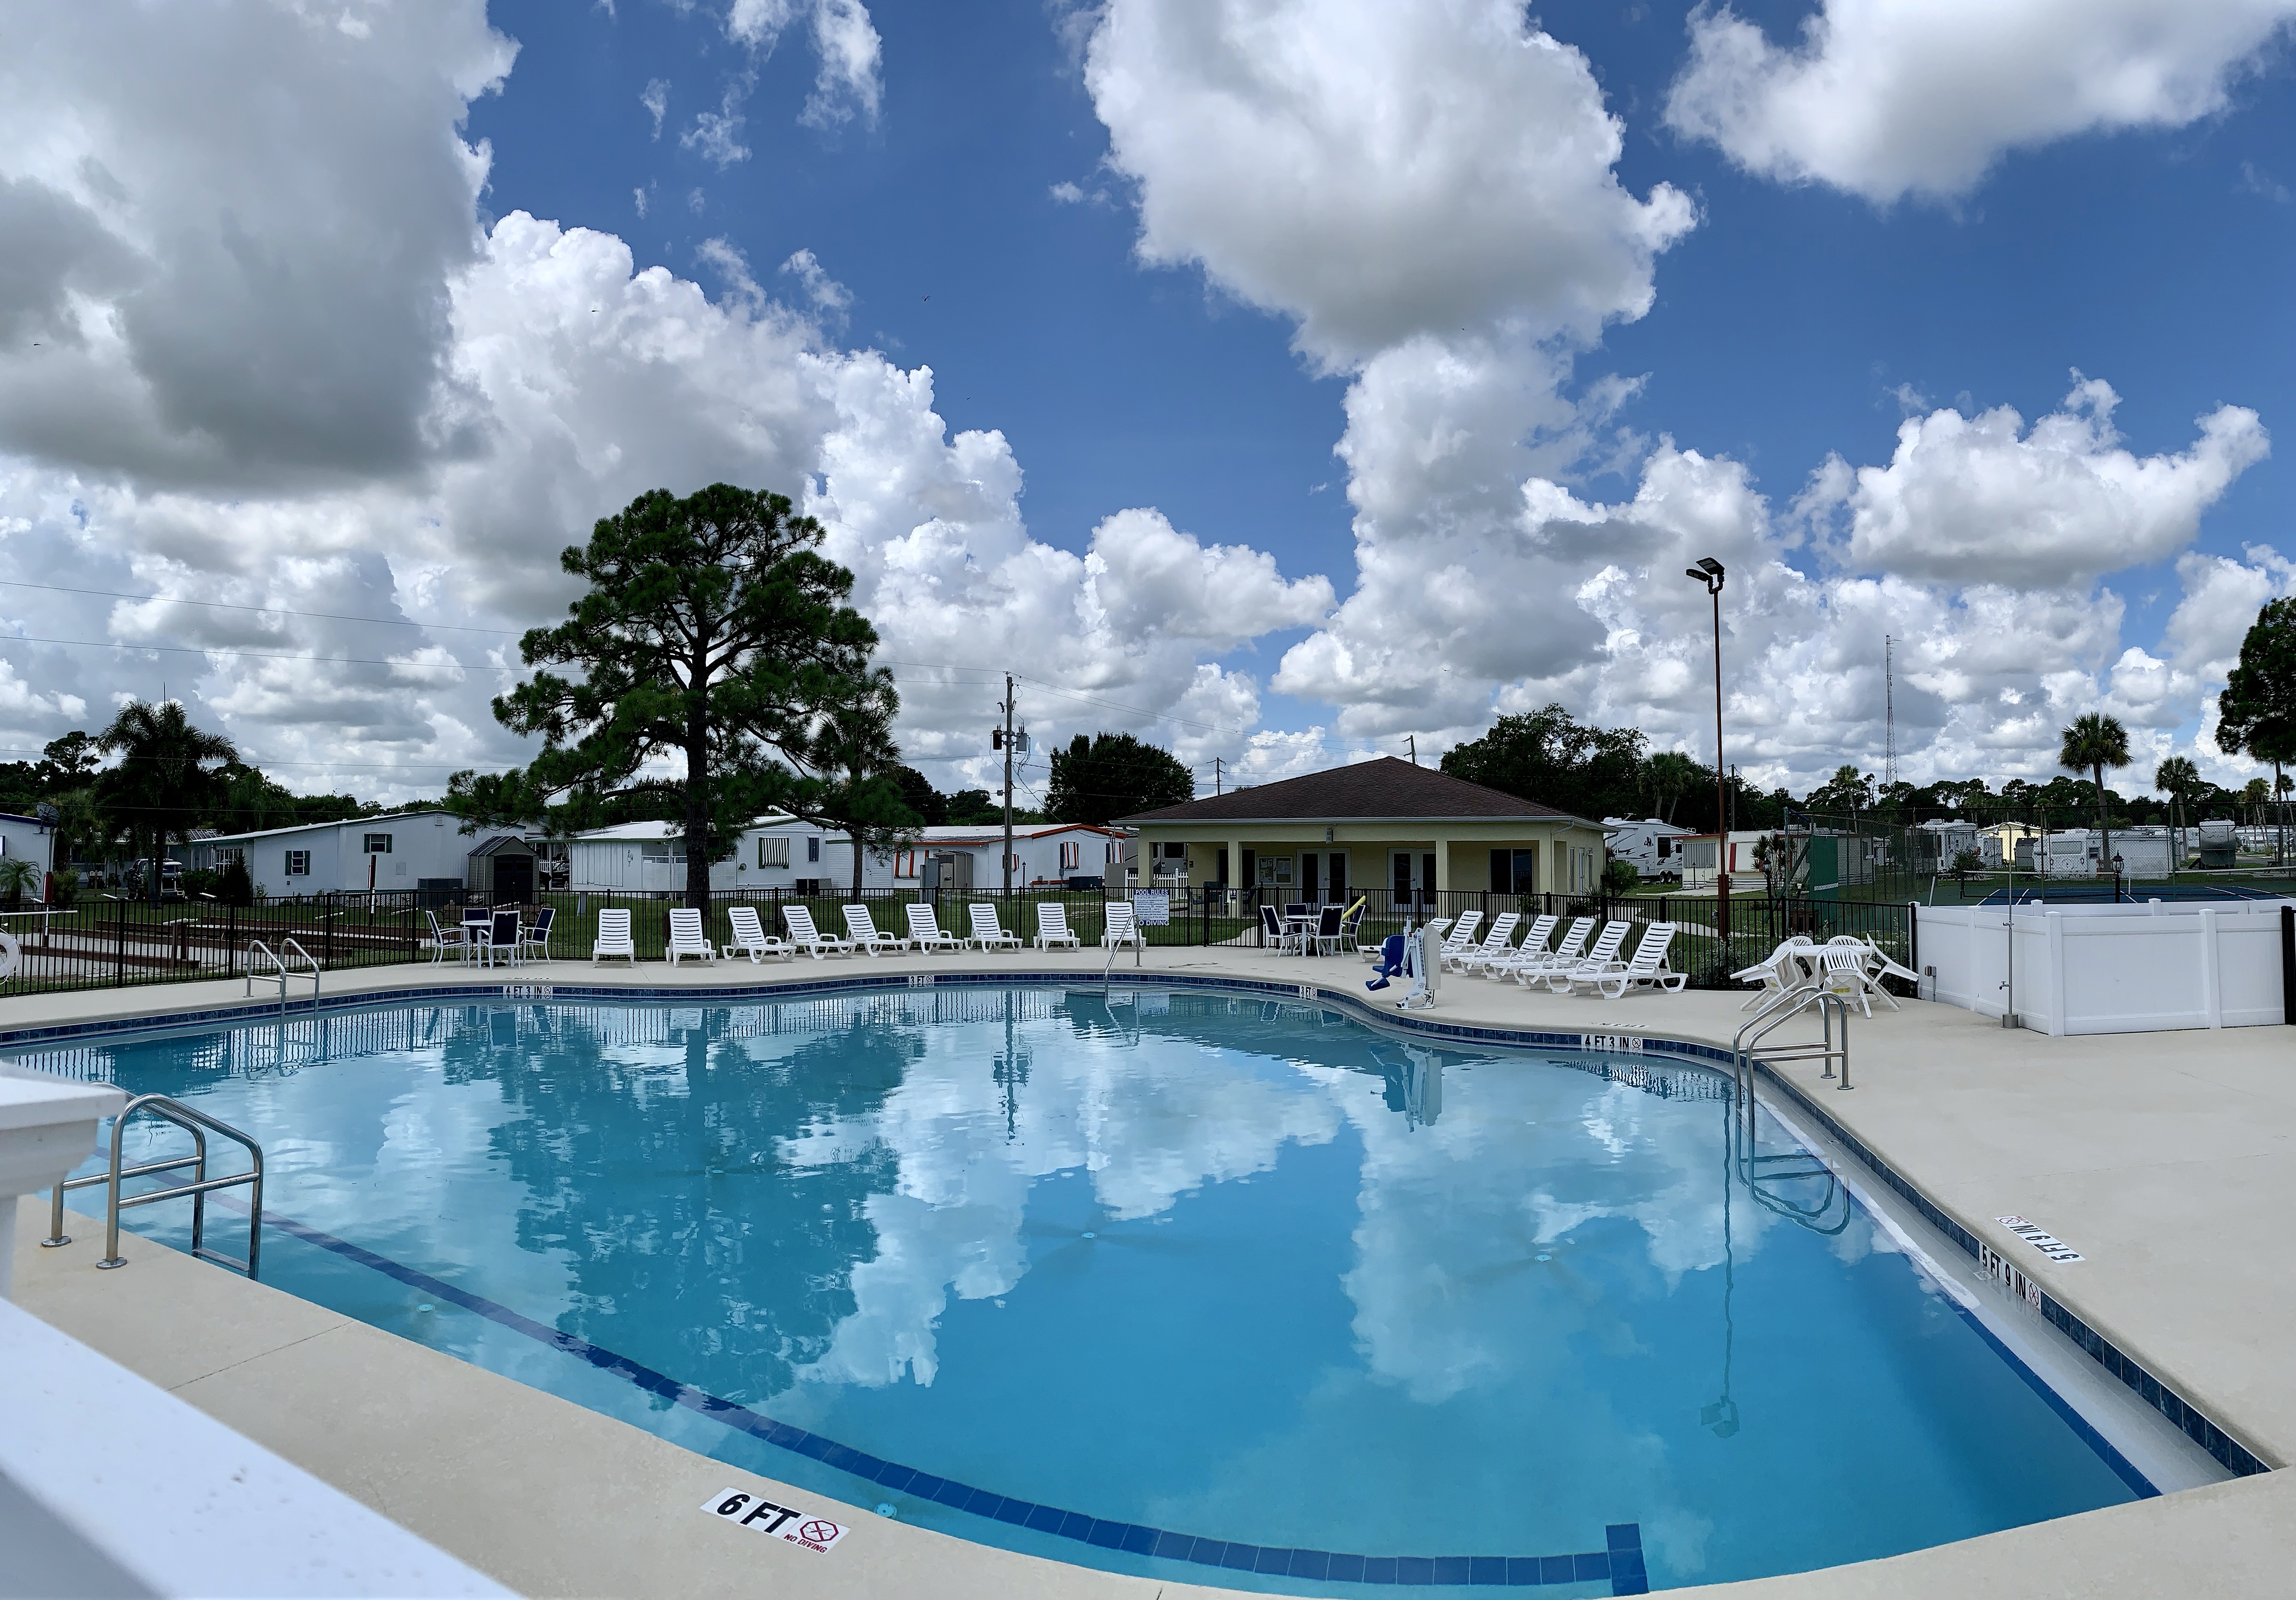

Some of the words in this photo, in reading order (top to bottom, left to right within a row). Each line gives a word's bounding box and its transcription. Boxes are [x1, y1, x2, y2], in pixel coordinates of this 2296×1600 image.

[1301, 986, 1304, 994] 3
[1585, 1035, 1591, 1045] 4
[1595, 1035, 1606, 1046] FT
[1609, 1036, 1615, 1046] 3
[1620, 1037, 1629, 1047] IN
[2009, 1225, 2042, 1233] IN
[2034, 1243, 2070, 1252] FT
[1982, 1244, 1987, 1267] 5
[1991, 1251, 2001, 1278] FT
[2005, 1263, 2010, 1286] 9
[2015, 1270, 2026, 1300] IN
[717, 1494, 751, 1515] 6
[739, 1502, 802, 1534] FT
[783, 1534, 798, 1542] NO
[797, 1538, 828, 1553] DIVING
